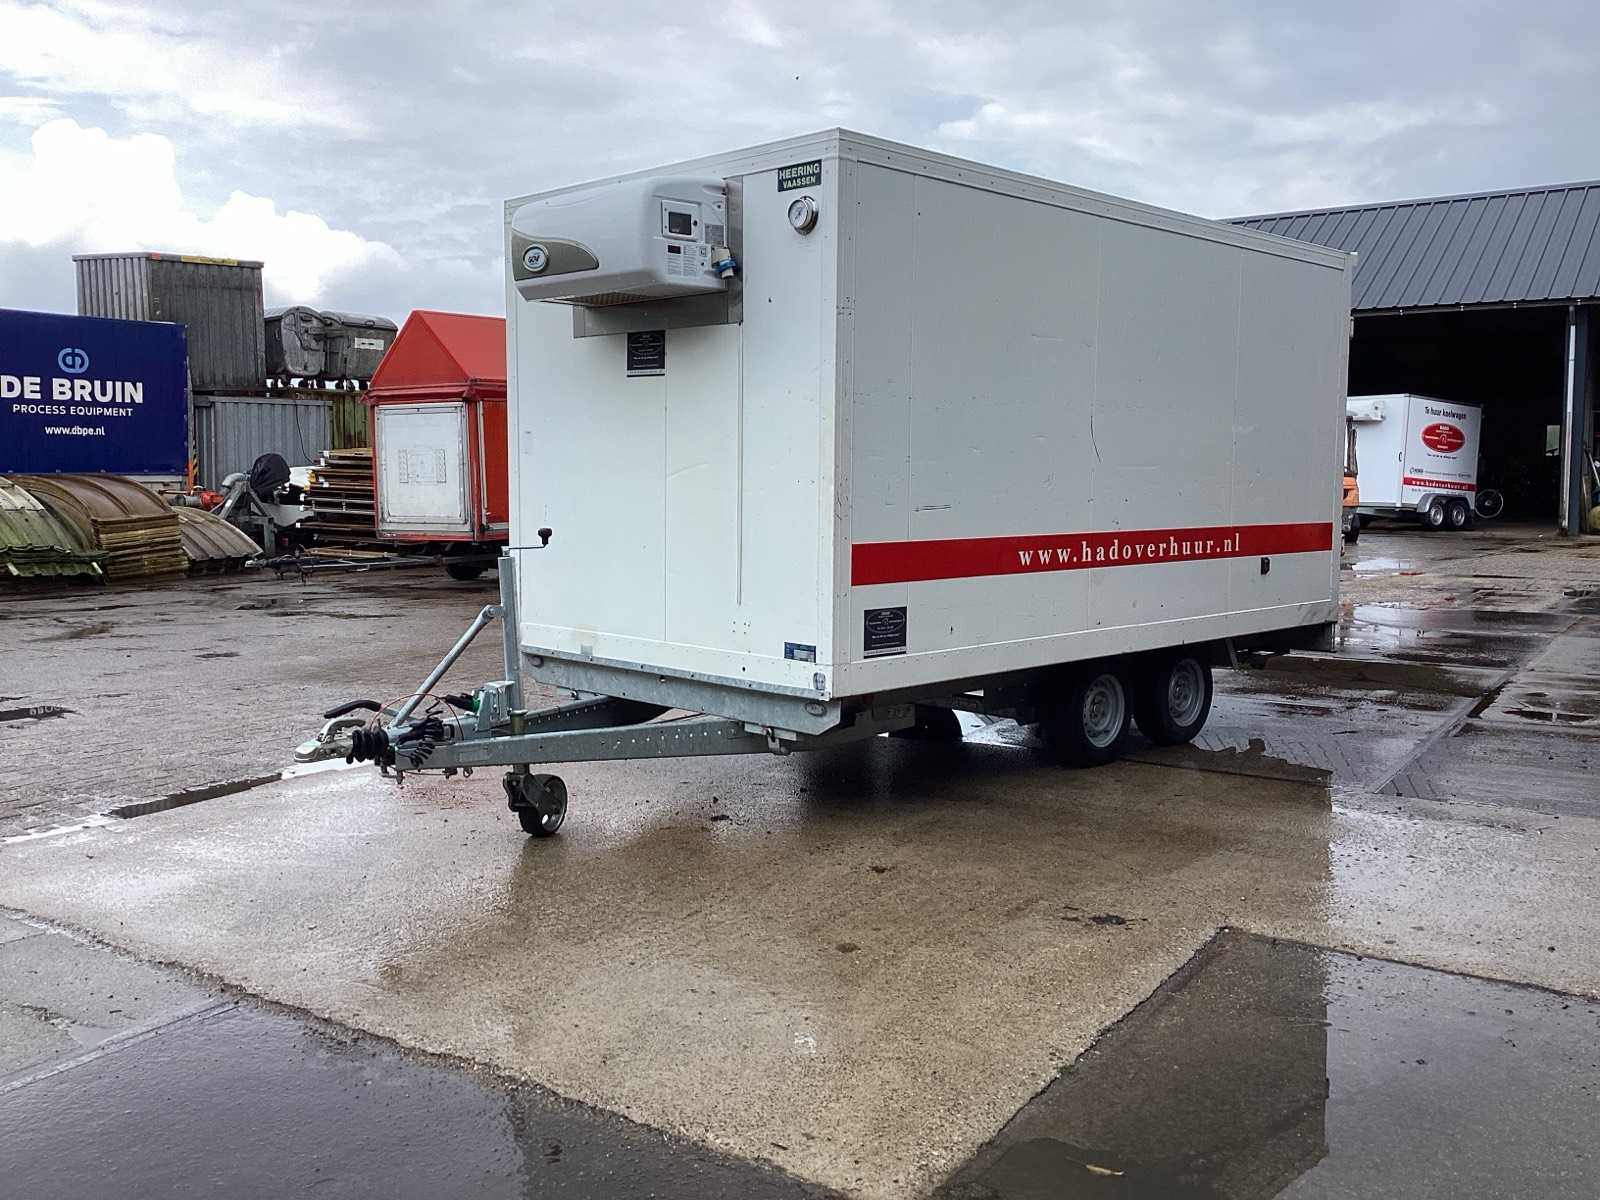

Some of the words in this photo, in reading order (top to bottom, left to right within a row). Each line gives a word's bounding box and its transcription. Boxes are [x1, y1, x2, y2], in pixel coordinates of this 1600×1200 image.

[779, 163, 820, 179] HEERING
[783, 176, 816, 189] VAASSEN
[0, 375, 41, 399] DE
[52, 378, 143, 403] BRUIN
[13, 404, 66, 415] PROCESS
[70, 406, 133, 417] EQUIPMENT
[45, 426, 105, 437] www.dbpe.nl
[1018, 533, 1240, 566] www.hadoverhuur.nl
